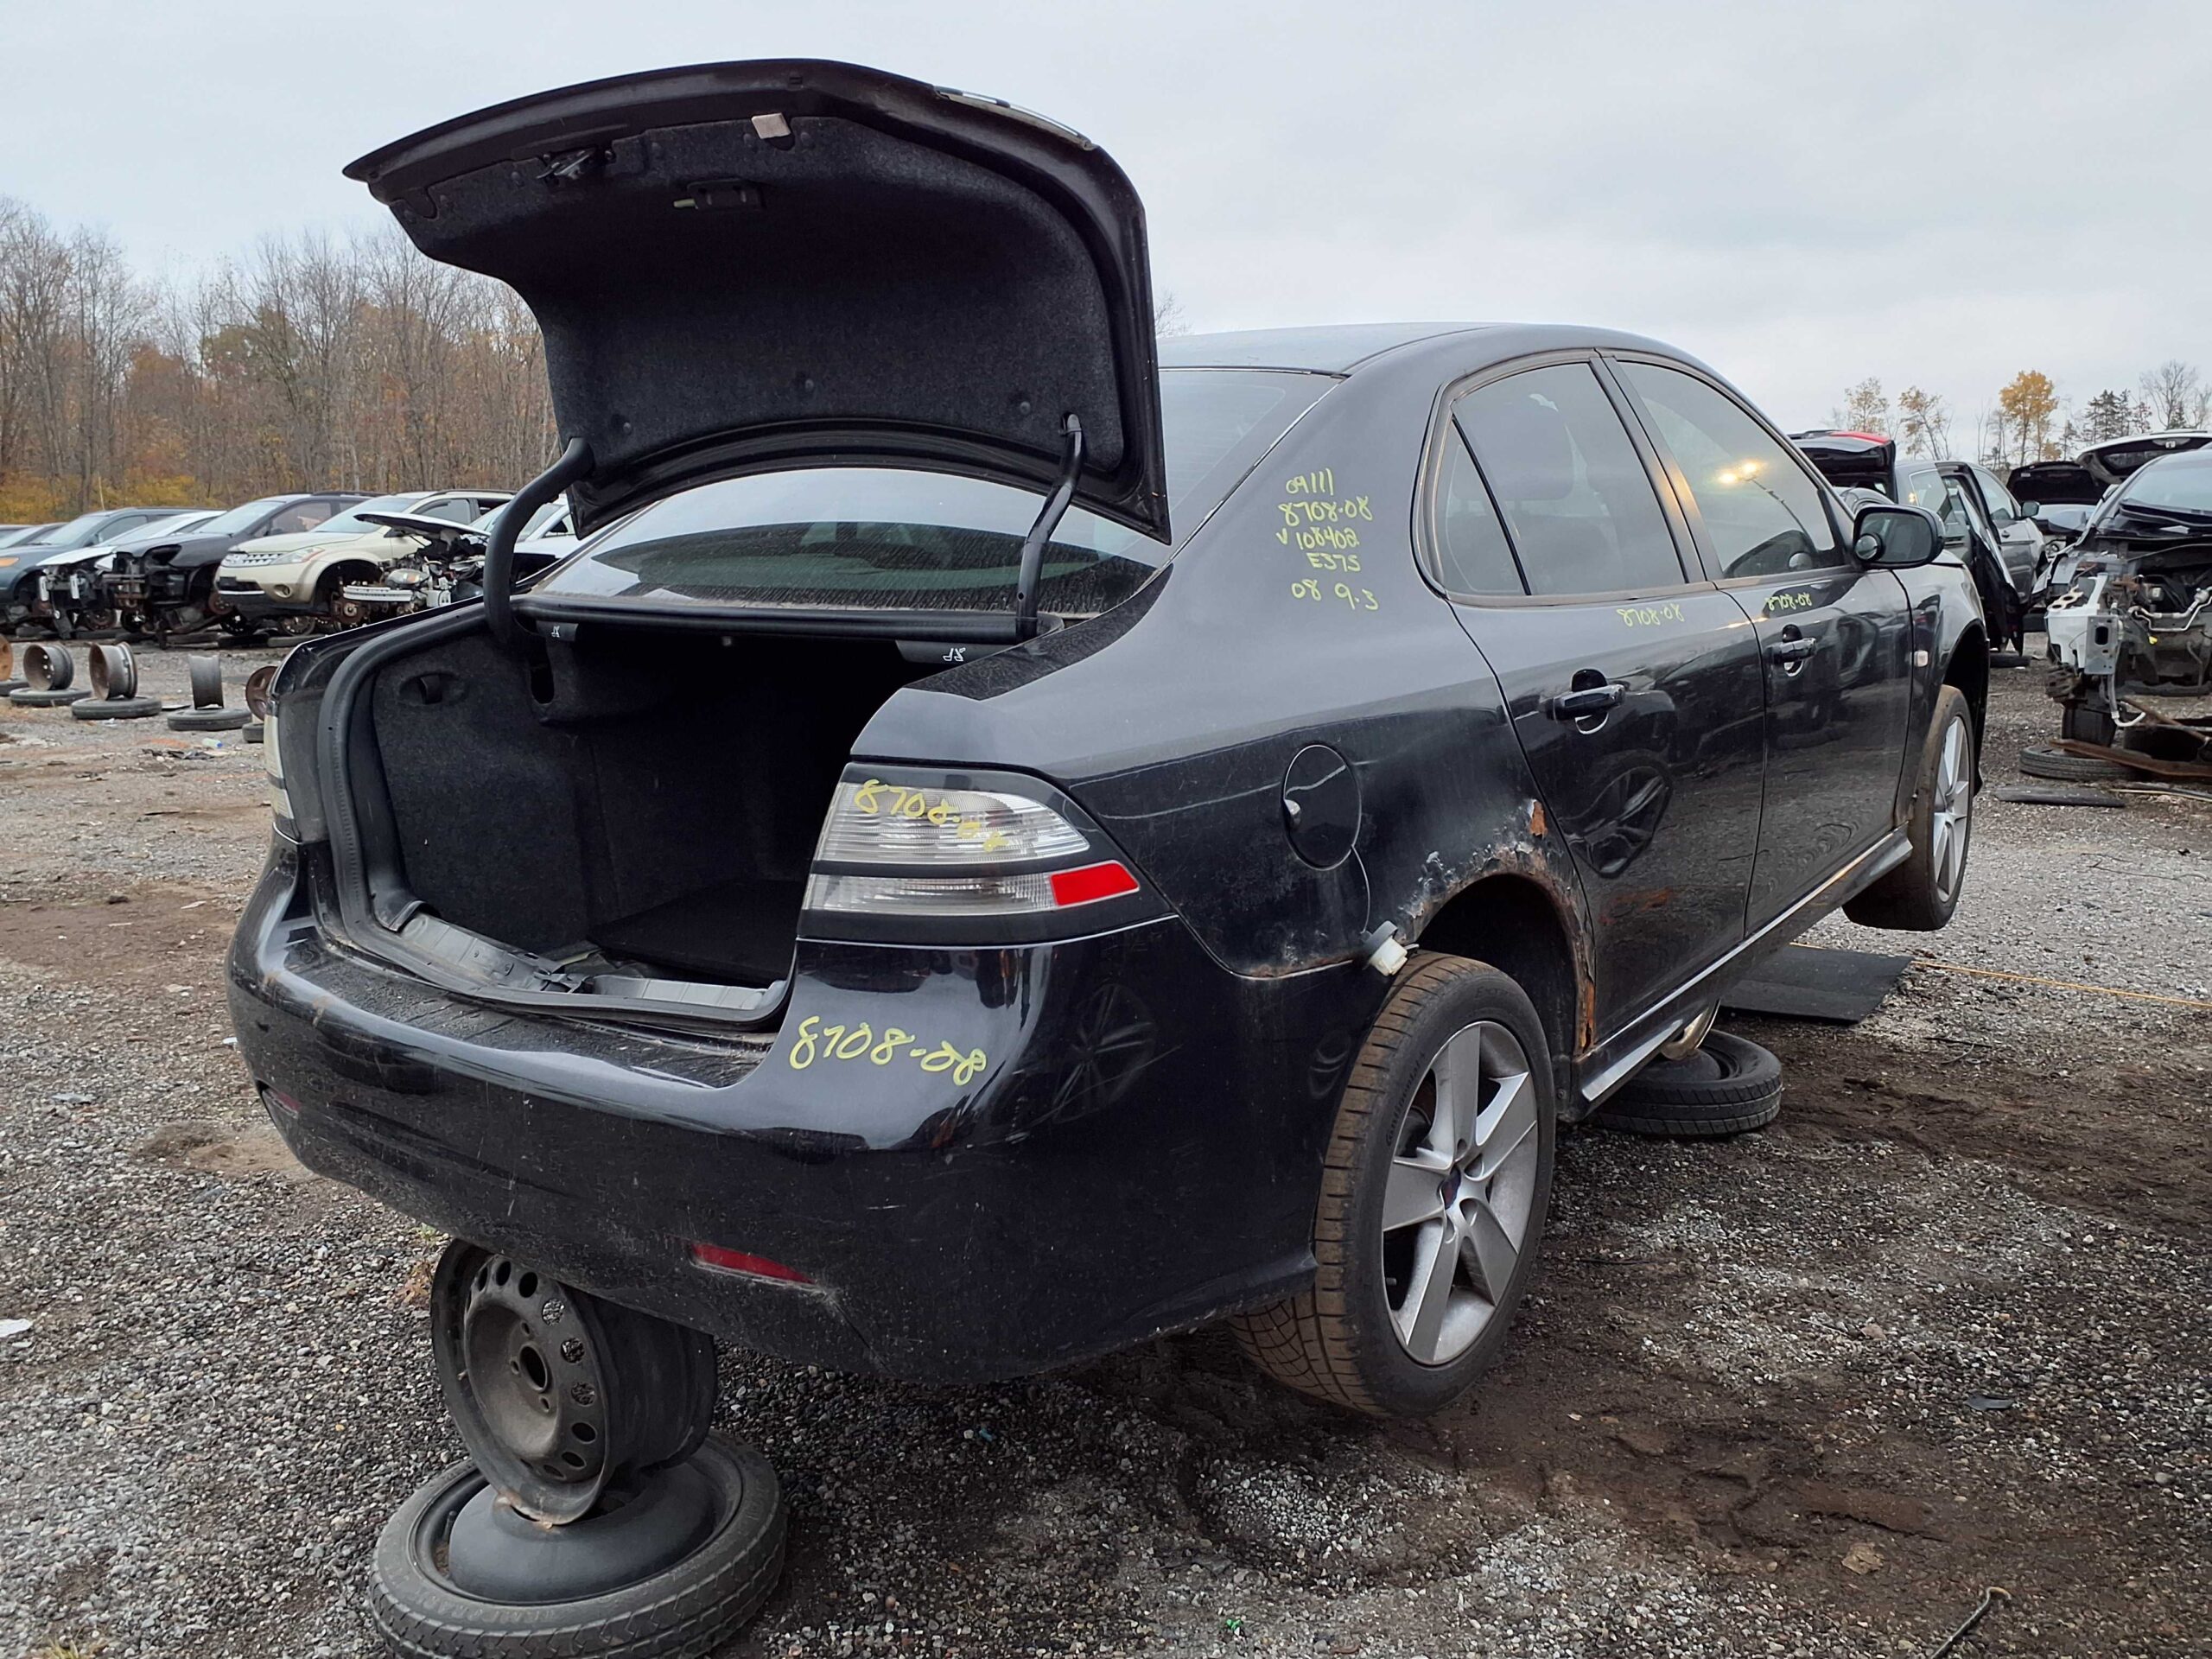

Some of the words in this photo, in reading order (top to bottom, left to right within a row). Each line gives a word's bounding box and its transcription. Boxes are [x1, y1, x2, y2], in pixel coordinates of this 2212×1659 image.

[1291, 578, 1322, 601] 08
[1334, 582, 1379, 610] 9.3
[789, 1015, 987, 1086] 8708-08
